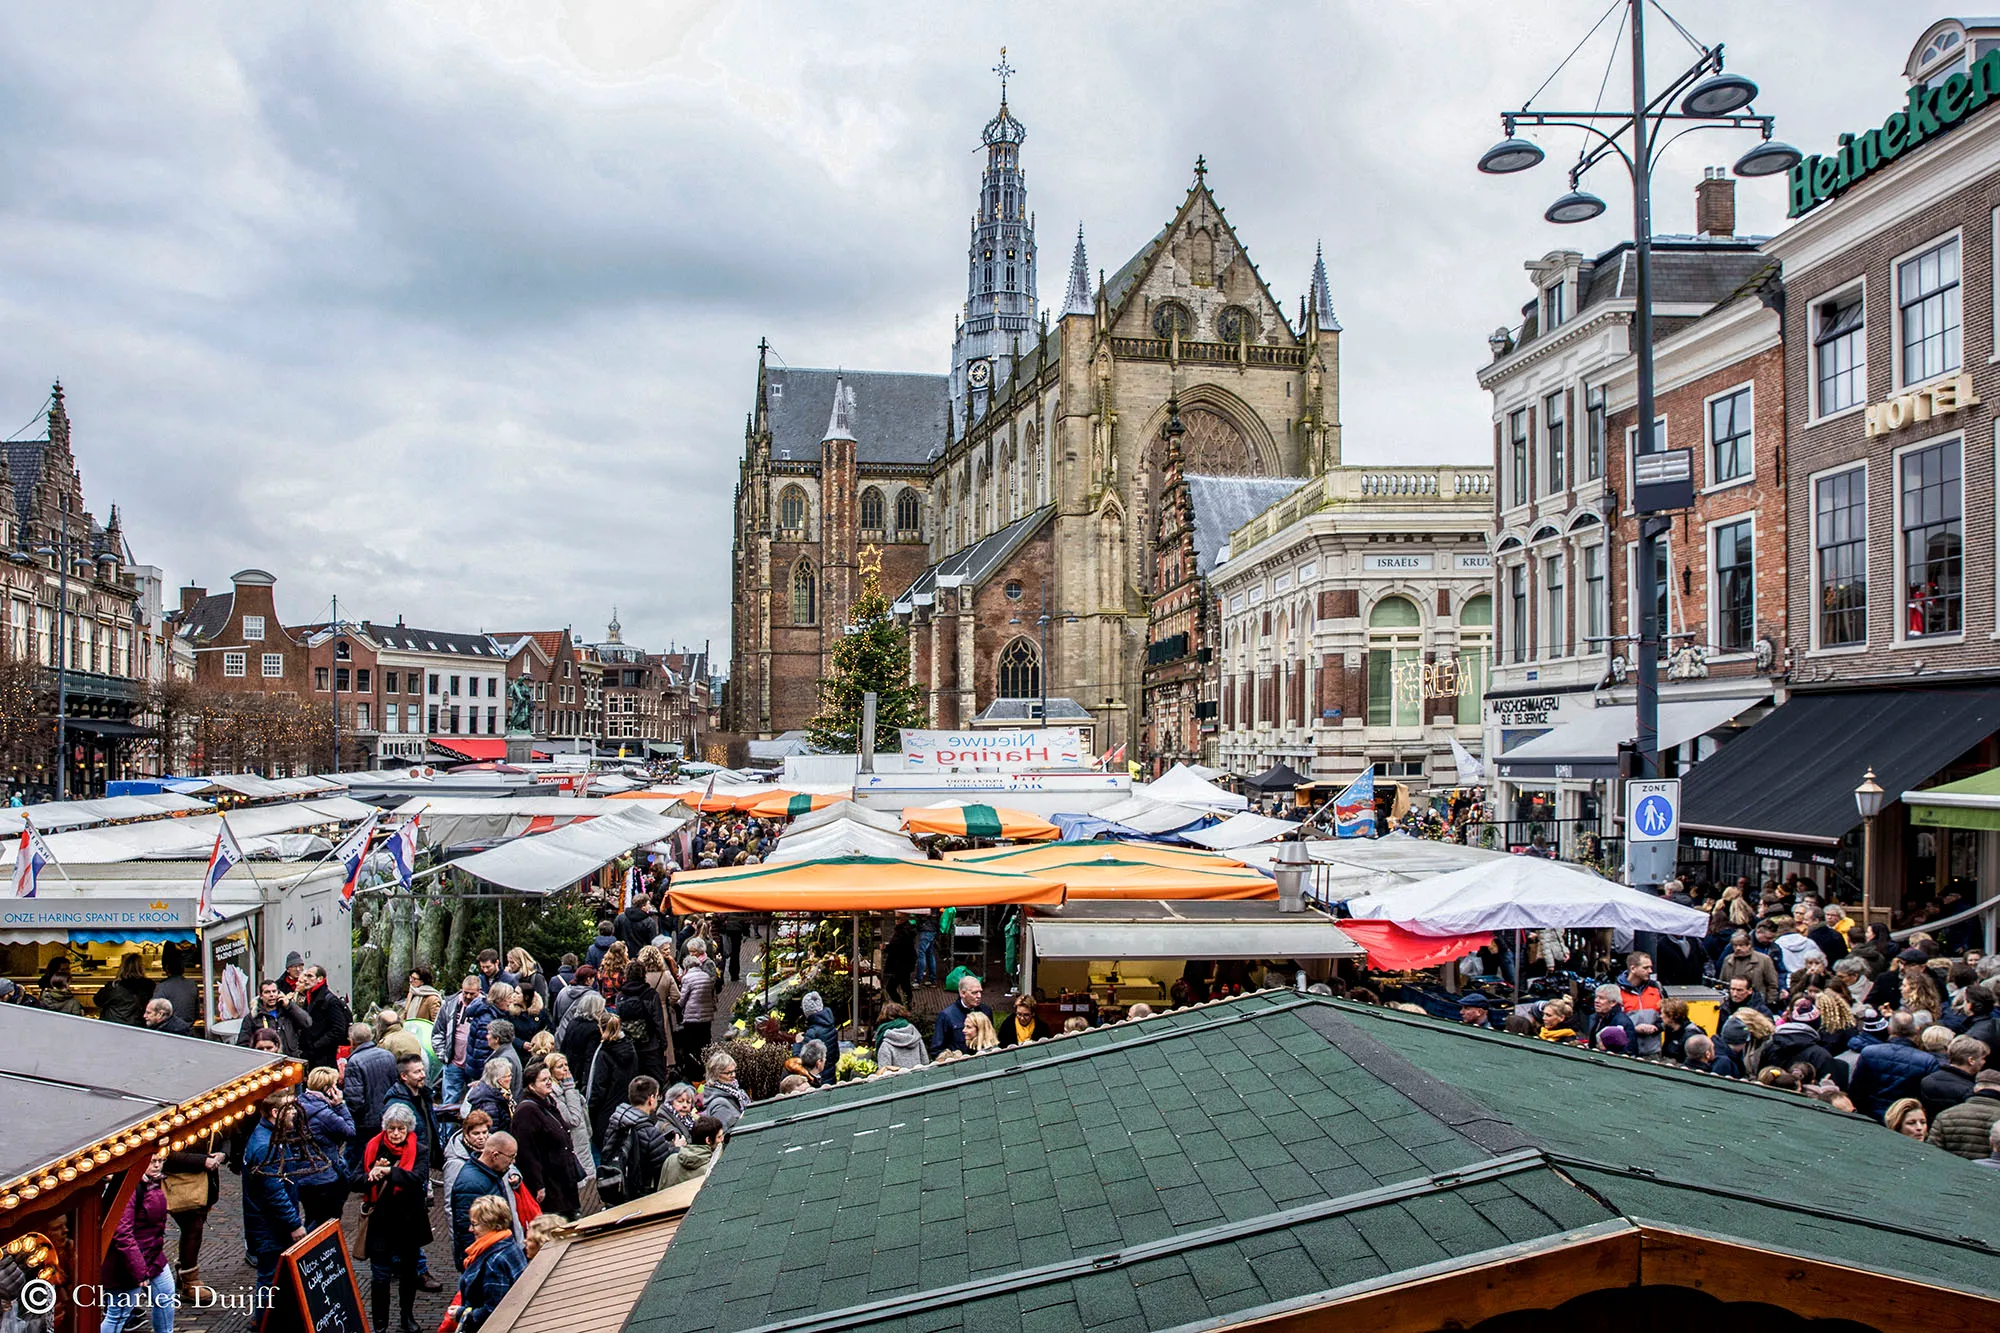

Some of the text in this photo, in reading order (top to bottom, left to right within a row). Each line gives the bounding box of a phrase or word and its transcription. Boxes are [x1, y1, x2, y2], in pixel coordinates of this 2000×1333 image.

[1786, 48, 2000, 219] Heineken
[1865, 374, 1981, 438] HOTEL
[1377, 557, 1419, 568] ISRAËLS
[1642, 784, 1667, 792] ZONE
[1693, 836, 1738, 851] THE SQUARE
[1754, 846, 1768, 856] FOOD
[1774, 848, 1793, 859] DRINKS
[4, 912, 179, 923] ONZE HARING SPANT DE KROON
